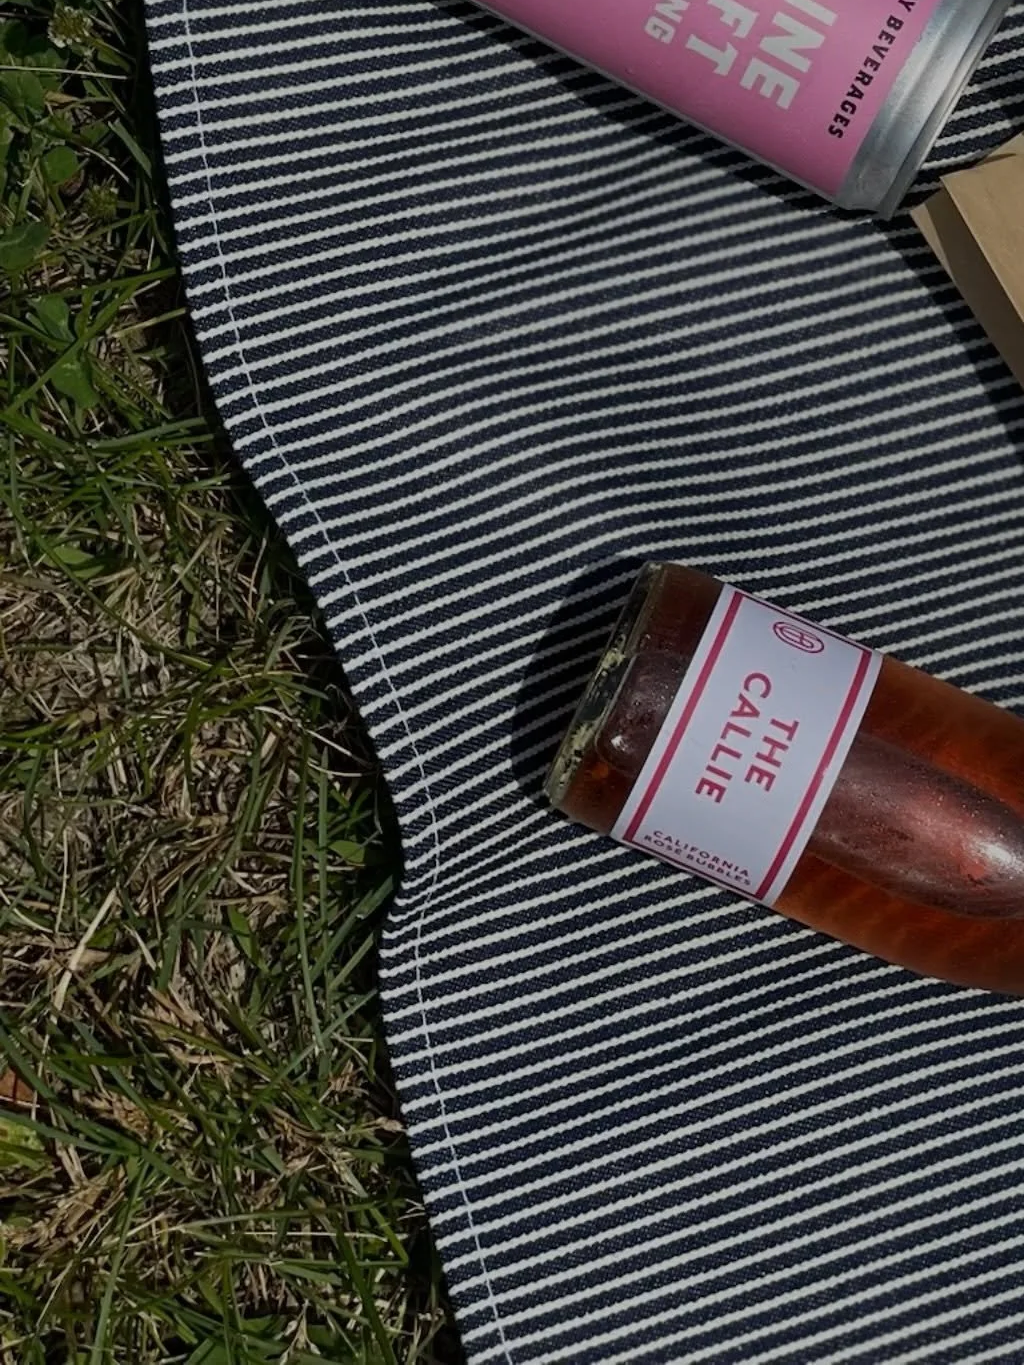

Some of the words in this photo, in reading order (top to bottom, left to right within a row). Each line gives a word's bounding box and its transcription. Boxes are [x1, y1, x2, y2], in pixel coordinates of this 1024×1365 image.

[826, 14, 903, 138] BEVERAGES
[694, 673, 774, 803] CALLIE
[743, 719, 799, 792] THE
[652, 829, 749, 877] CALIFORNIA
[685, 852, 752, 886] BUBBLES
